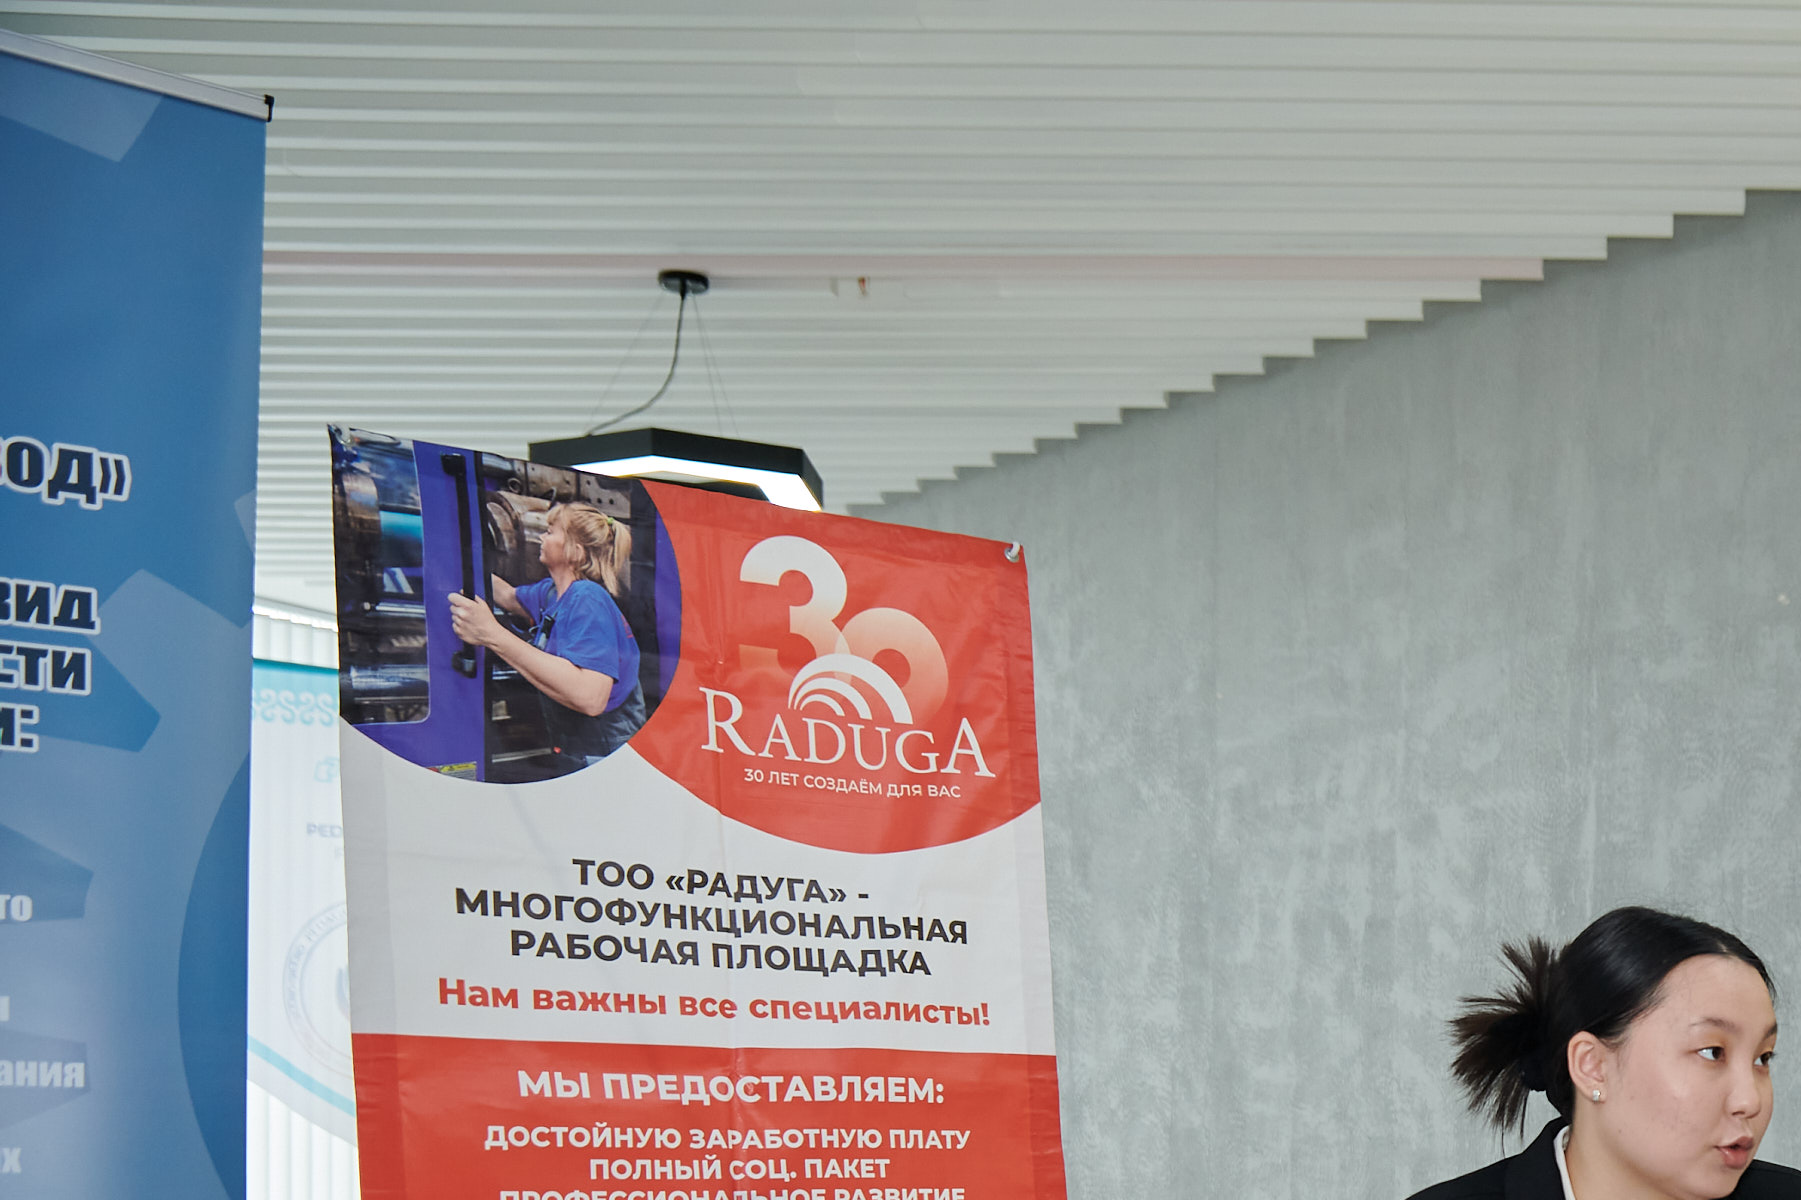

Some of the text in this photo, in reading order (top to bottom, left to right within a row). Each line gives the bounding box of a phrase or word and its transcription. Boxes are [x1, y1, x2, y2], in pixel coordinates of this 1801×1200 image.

[0, 438, 131, 509] ОД»
[700, 686, 996, 778] RADUGA
[744, 768, 961, 799] 30 ЛЕТ СОЗДАЁМ ДЛЯ ВАС
[572, 858, 654, 890] ТОО
[666, 869, 847, 904] «РАДУГА»
[455, 887, 968, 945] МНОГОФУНКЦИОНАЛЬНАЯ
[510, 930, 931, 978] РАБОЧАЯ ПЛОЩАДКА
[438, 978, 990, 1027] Нам важны все специалисты!
[518, 1070, 944, 1106] МЫ ПРЕДОСТАВЛЯЕМ:
[484, 1122, 971, 1151] ДОСТОЙНУЮ ЗАРАБОТНУЮ ПЛАТУ
[590, 1154, 890, 1183] ПОЛНЫЙ СОЦ. ПАКЕТ
